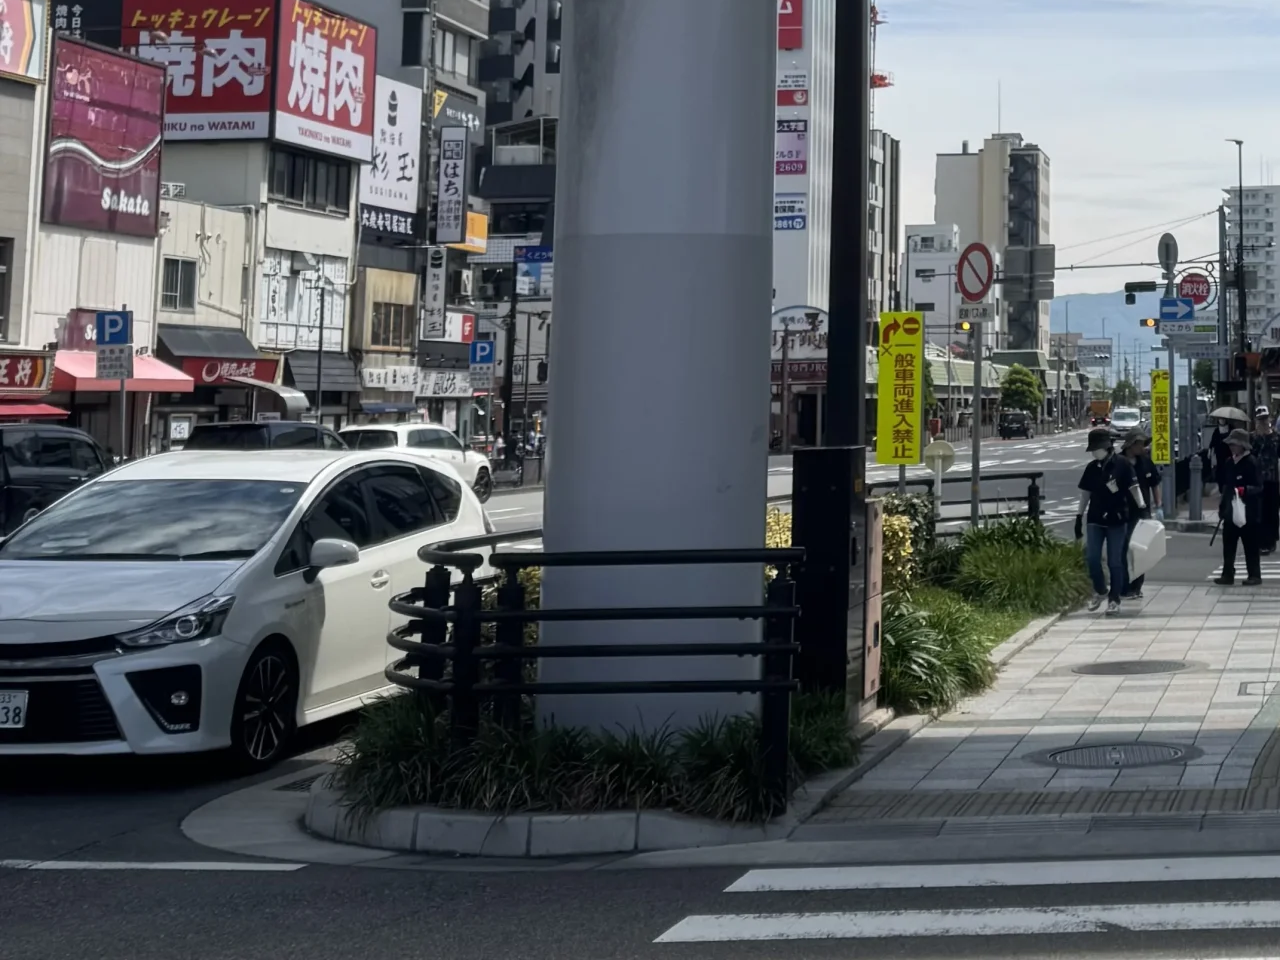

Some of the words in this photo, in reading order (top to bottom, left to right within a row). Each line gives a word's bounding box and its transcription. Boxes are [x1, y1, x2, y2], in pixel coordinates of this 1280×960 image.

[55, 4, 68, 36] 焼肉
[131, 7, 271, 29] トッキュウレーン
[287, 20, 365, 128] 焼肉
[208, 120, 256, 132] WATAMI
[369, 146, 415, 182] 杉玉
[100, 187, 150, 216] Sakata
[1181, 282, 1209, 296] 消火栓
[104, 314, 124, 342] P
[1161, 324, 1192, 333] ここから
[476, 343, 490, 362] P
[891, 343, 916, 460] 一般車両進入禁止
[1154, 391, 1169, 462] 一般車両進入禁止
